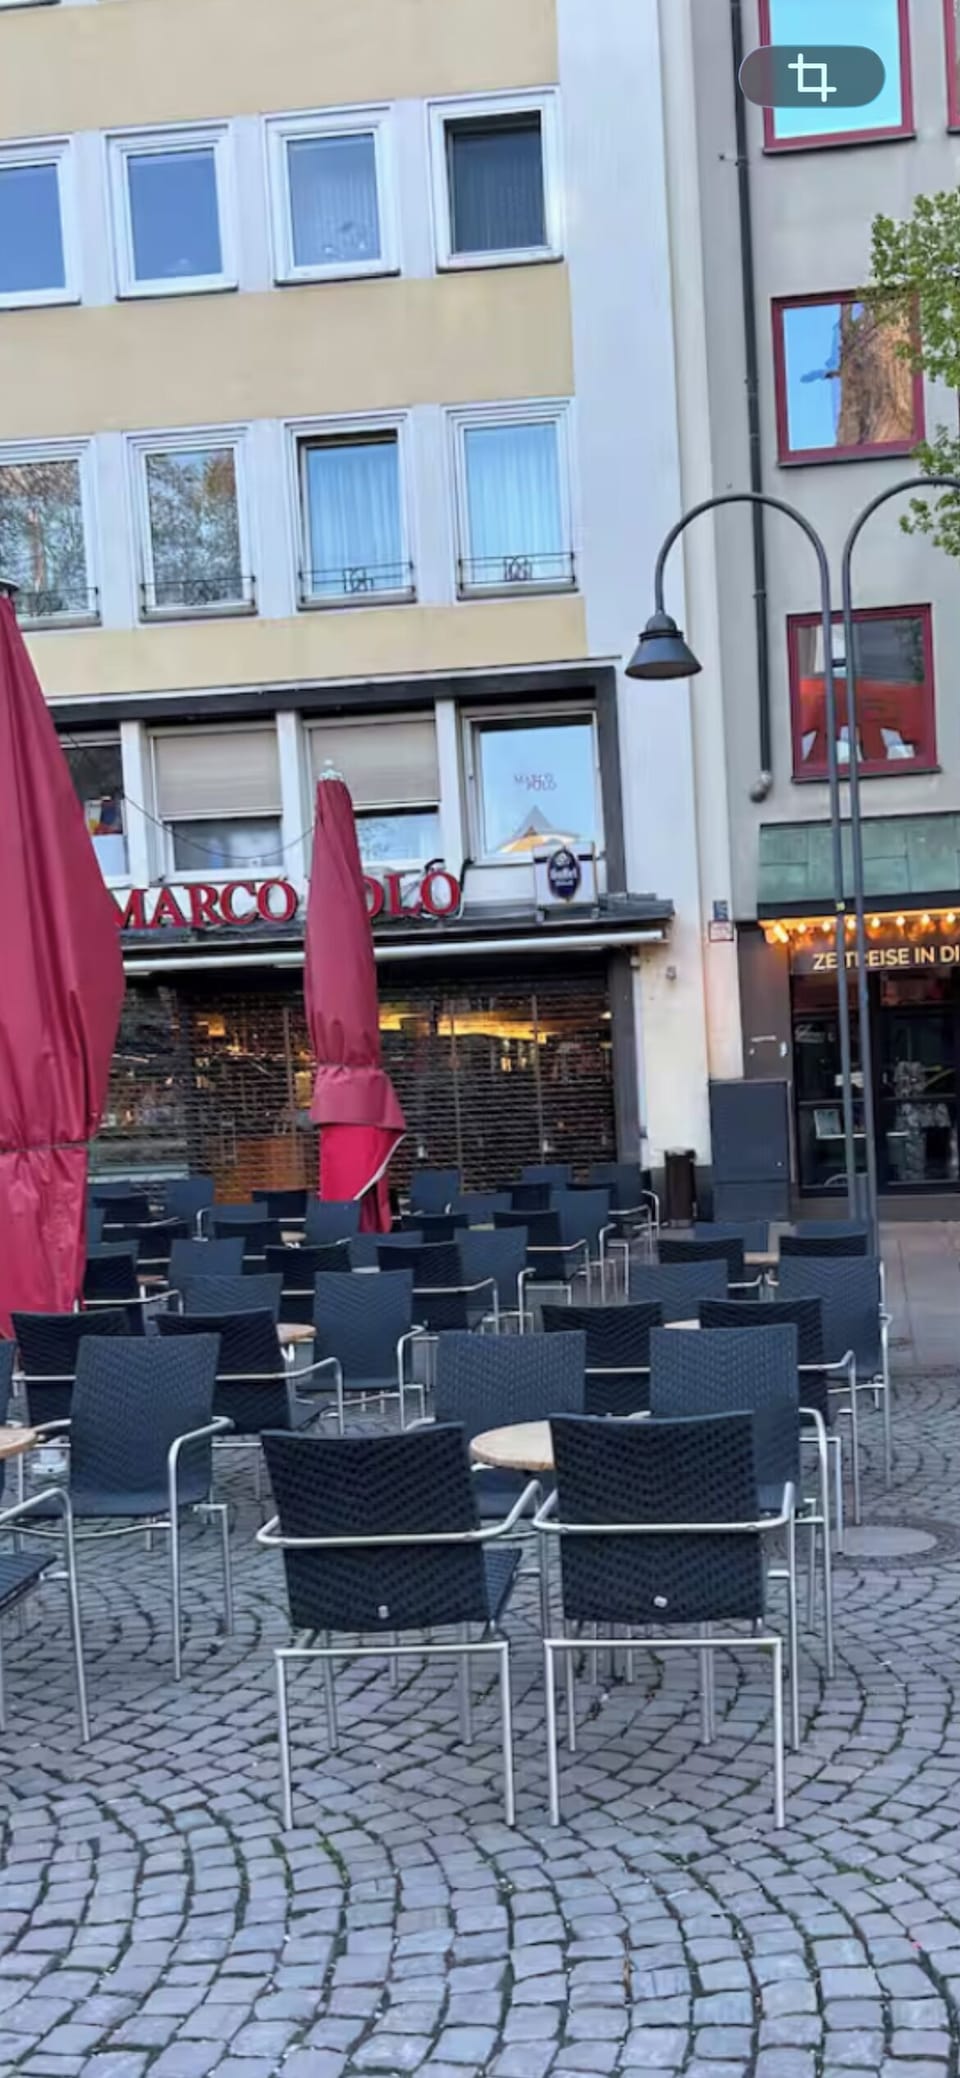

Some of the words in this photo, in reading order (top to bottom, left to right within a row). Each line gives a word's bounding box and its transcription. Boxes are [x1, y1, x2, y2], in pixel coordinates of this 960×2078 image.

[112, 880, 298, 929] MARCO
[361, 870, 460, 917] OLO
[813, 948, 909, 971] ZETEISE
[914, 946, 935, 963] IN
